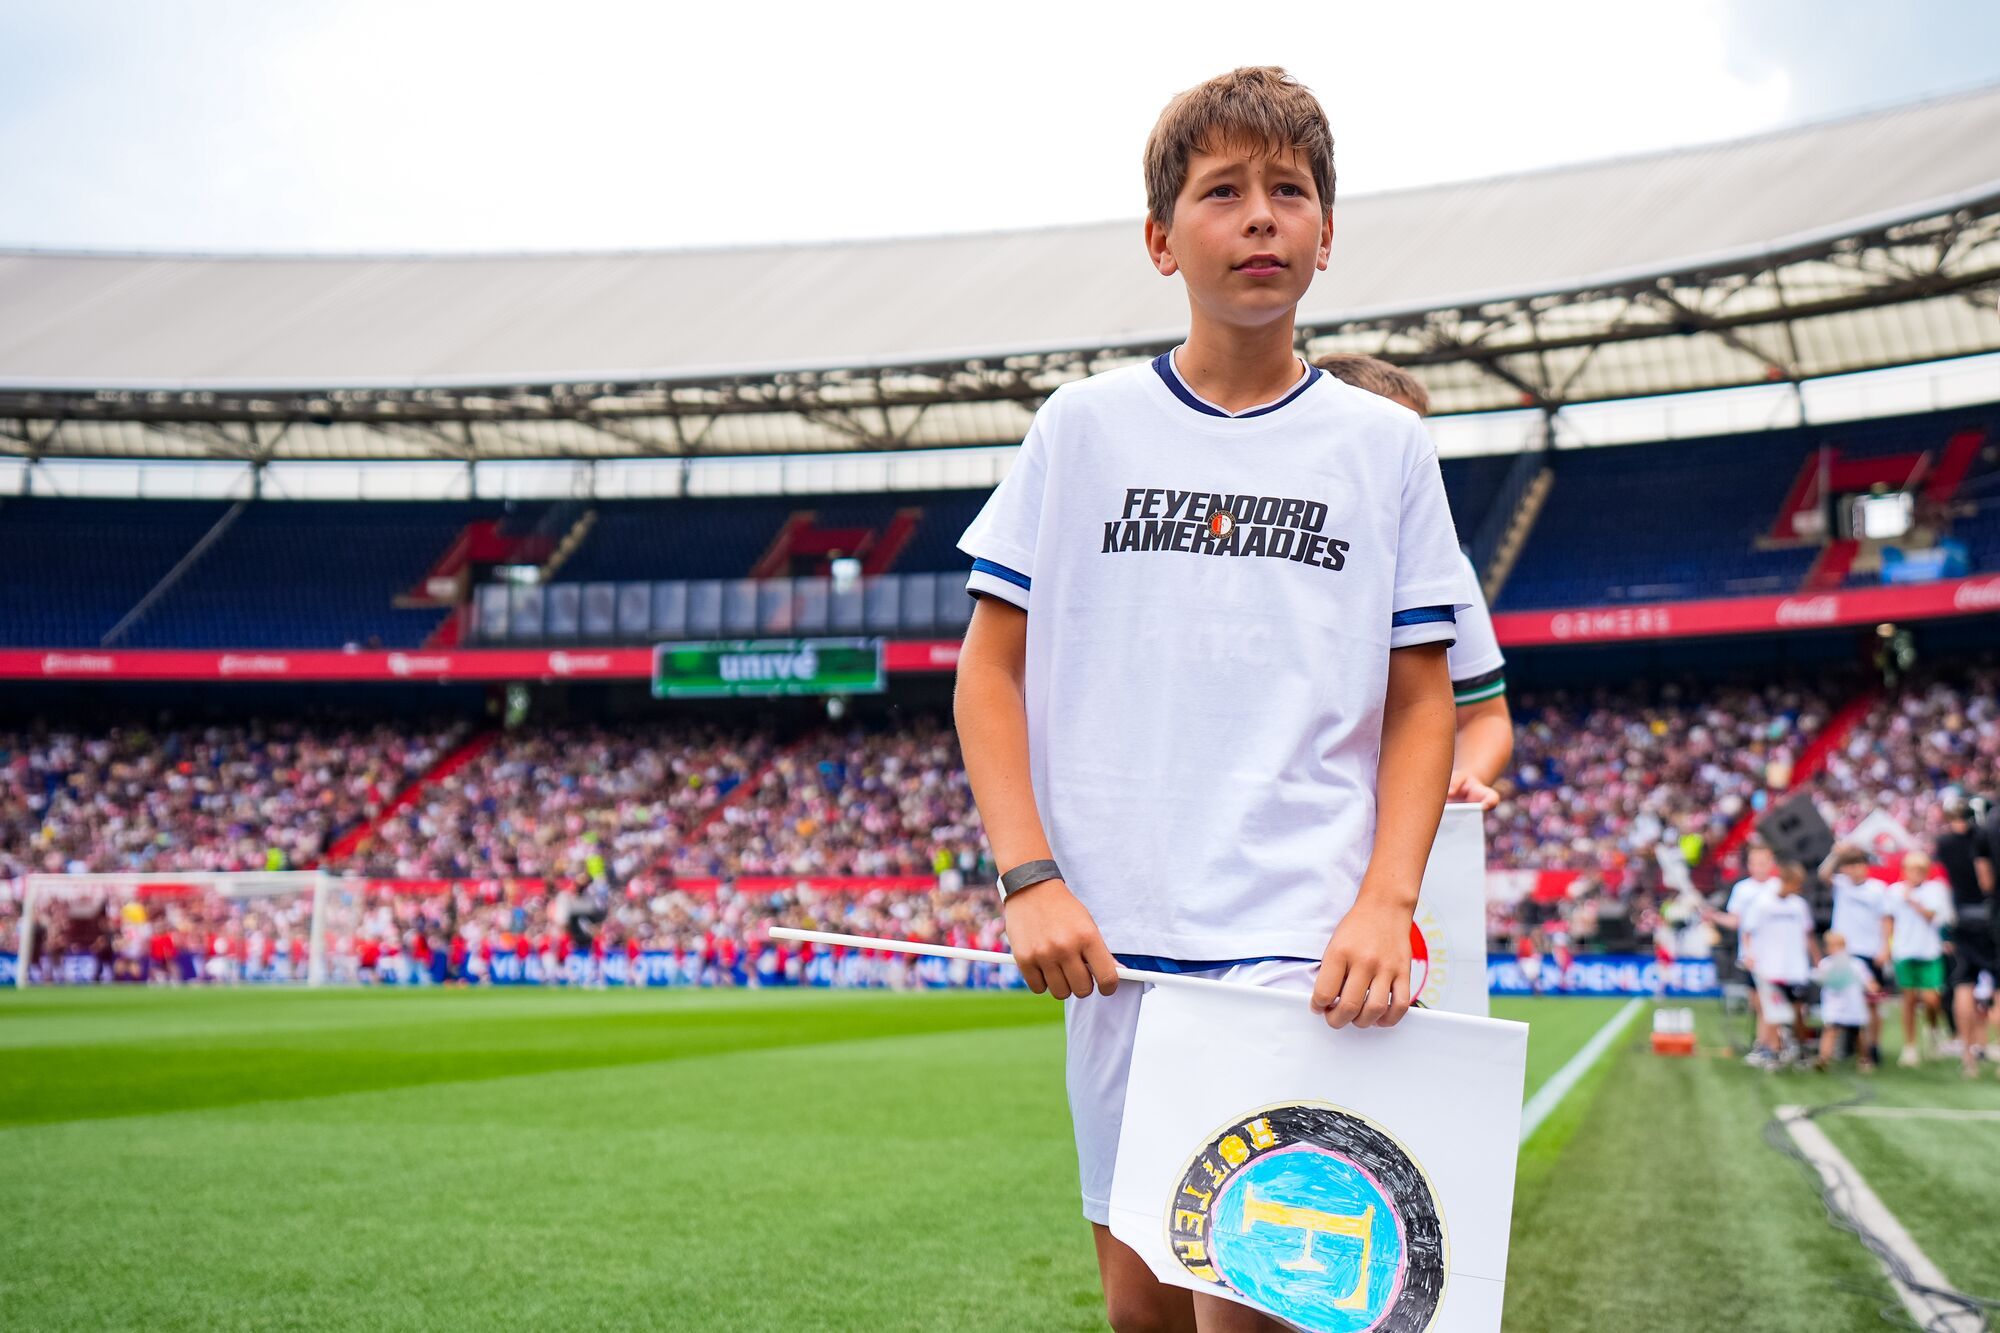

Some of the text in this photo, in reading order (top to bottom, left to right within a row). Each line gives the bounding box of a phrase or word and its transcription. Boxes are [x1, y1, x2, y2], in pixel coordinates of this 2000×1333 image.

[1121, 488, 1329, 533] FEYENOORD
[1101, 520, 1350, 572] KAMERAADJES
[1242, 1181, 1376, 1311] F
